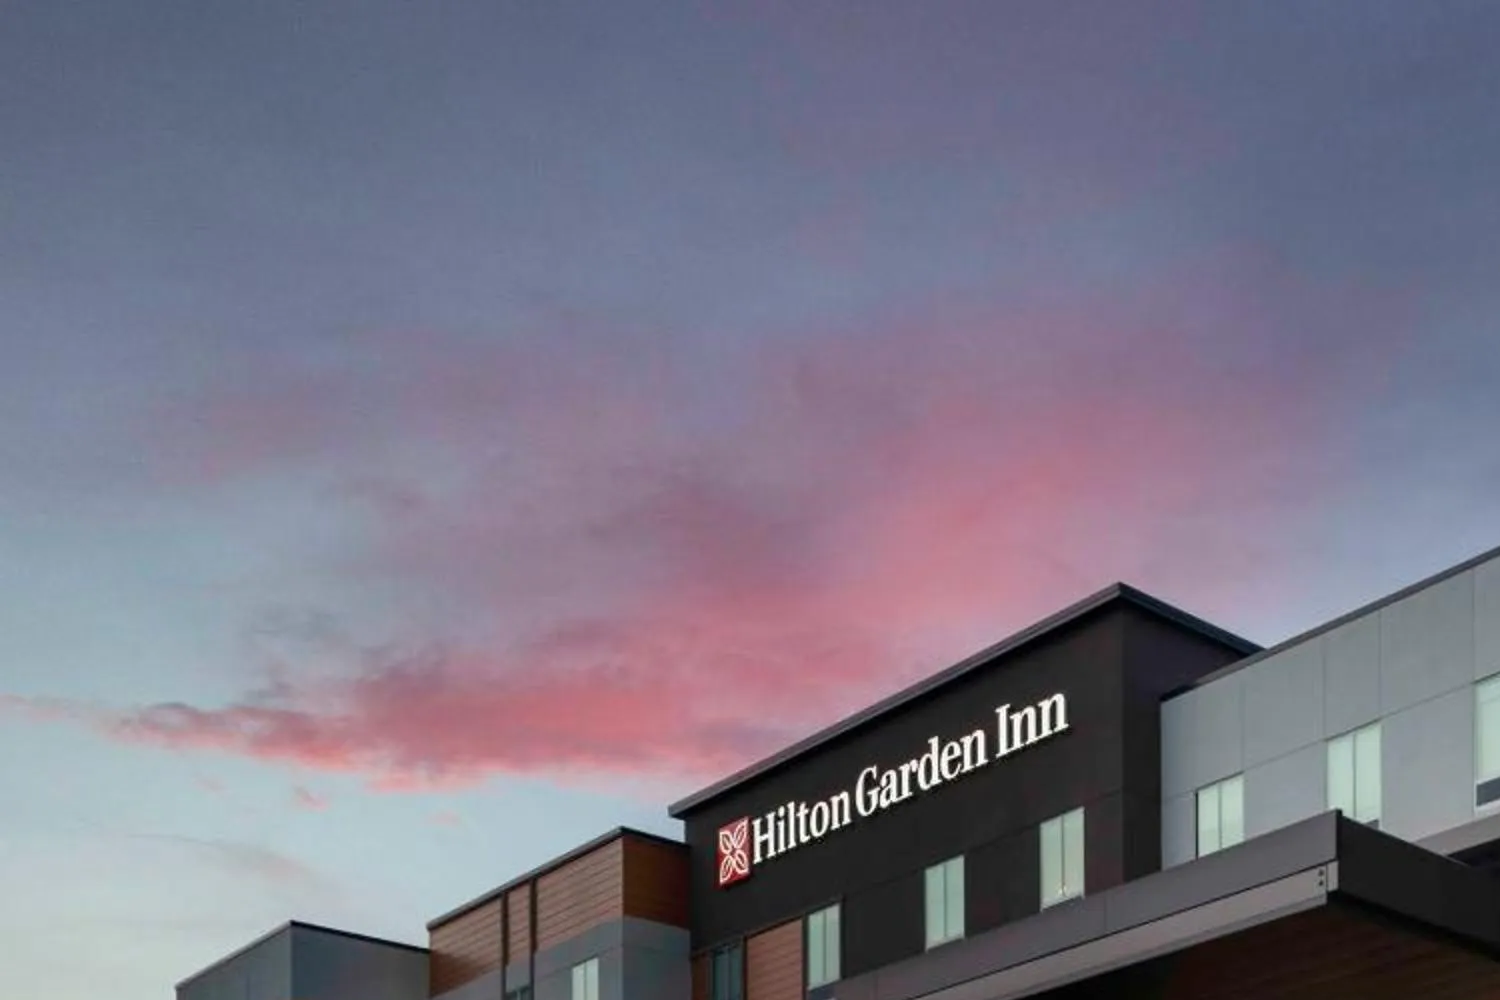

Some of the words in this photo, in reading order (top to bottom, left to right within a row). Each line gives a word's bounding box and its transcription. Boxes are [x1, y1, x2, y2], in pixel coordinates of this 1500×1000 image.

[752, 791, 851, 864] Hilton
[856, 729, 988, 817] Garden
[995, 692, 1069, 758] Inn
